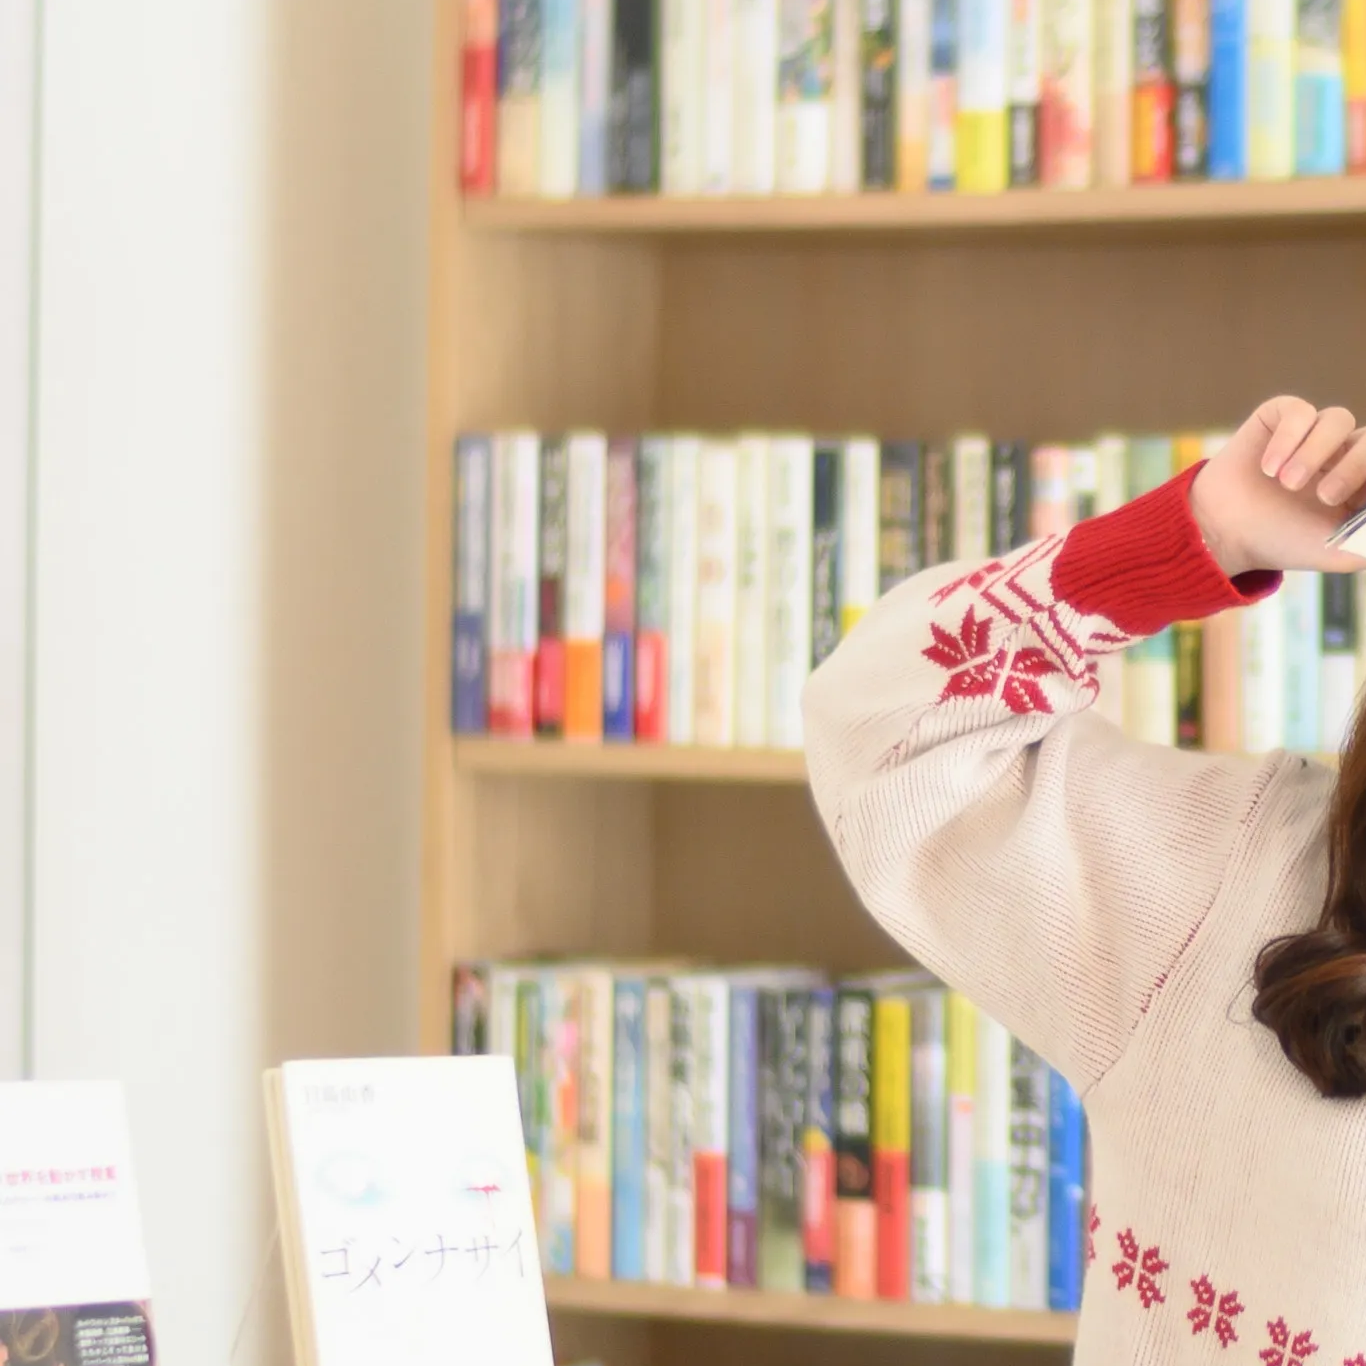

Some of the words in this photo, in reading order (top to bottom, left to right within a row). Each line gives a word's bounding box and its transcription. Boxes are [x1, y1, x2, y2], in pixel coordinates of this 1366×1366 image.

[320, 1228, 525, 1294] ゴメンナサイ
